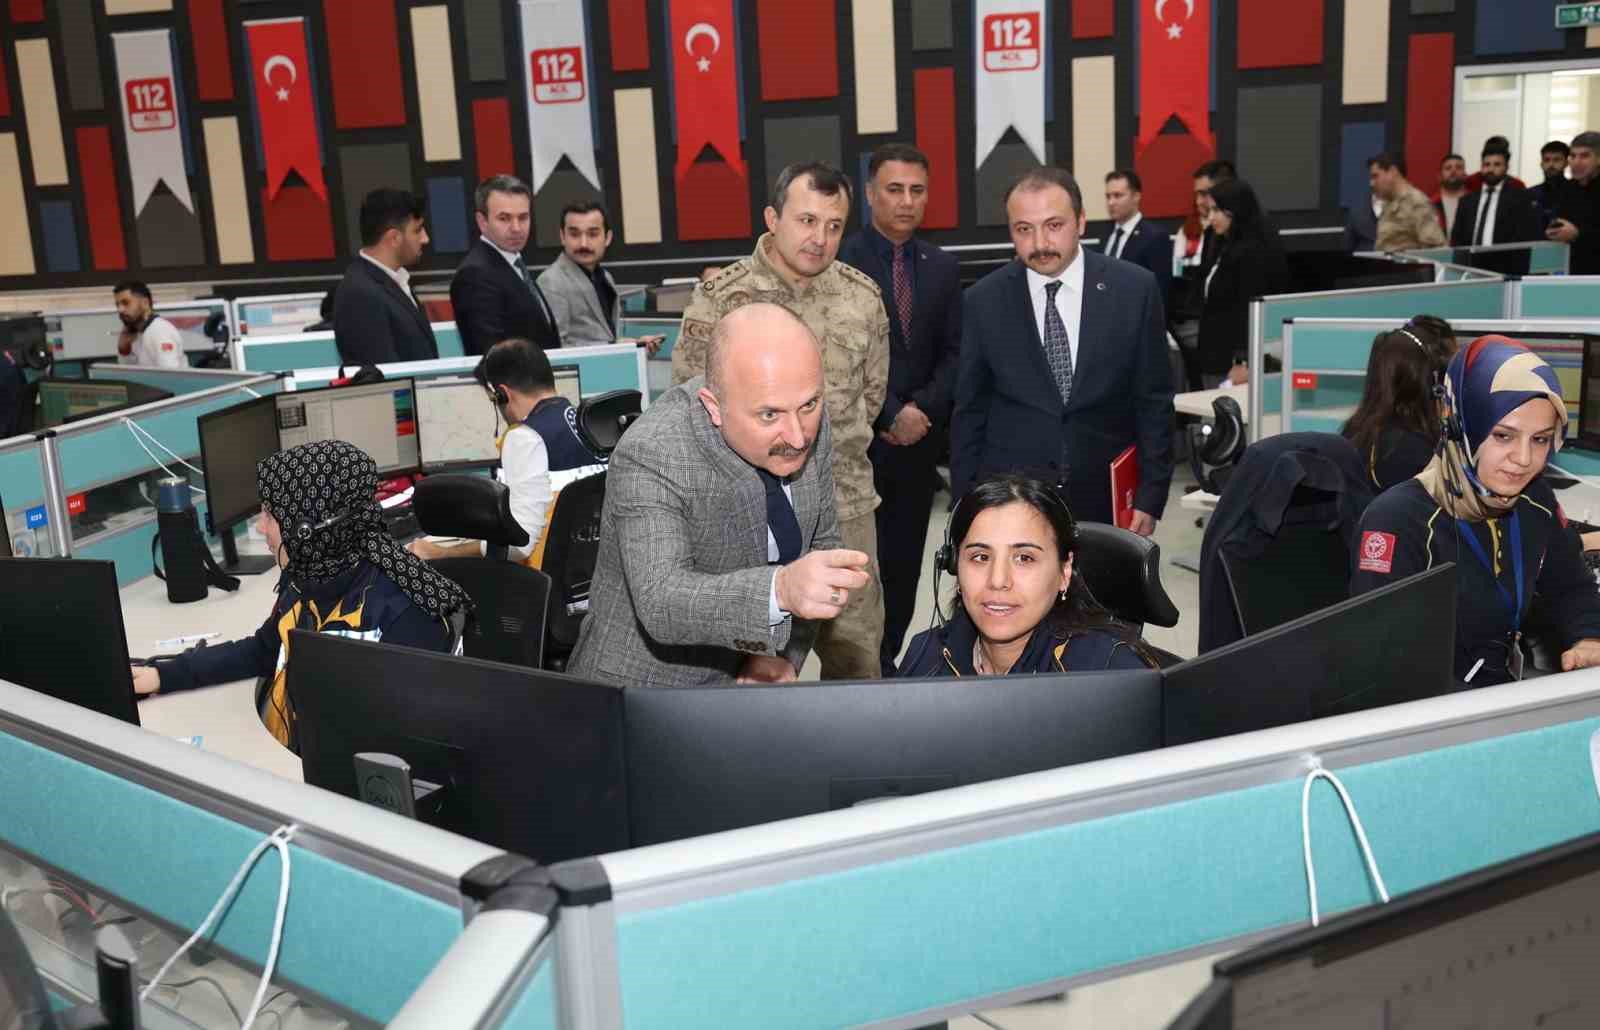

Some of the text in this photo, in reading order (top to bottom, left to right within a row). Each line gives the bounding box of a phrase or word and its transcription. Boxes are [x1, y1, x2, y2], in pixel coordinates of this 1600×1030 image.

[991, 18, 1032, 48] 112
[538, 54, 576, 81] 112
[132, 83, 166, 110] 112
